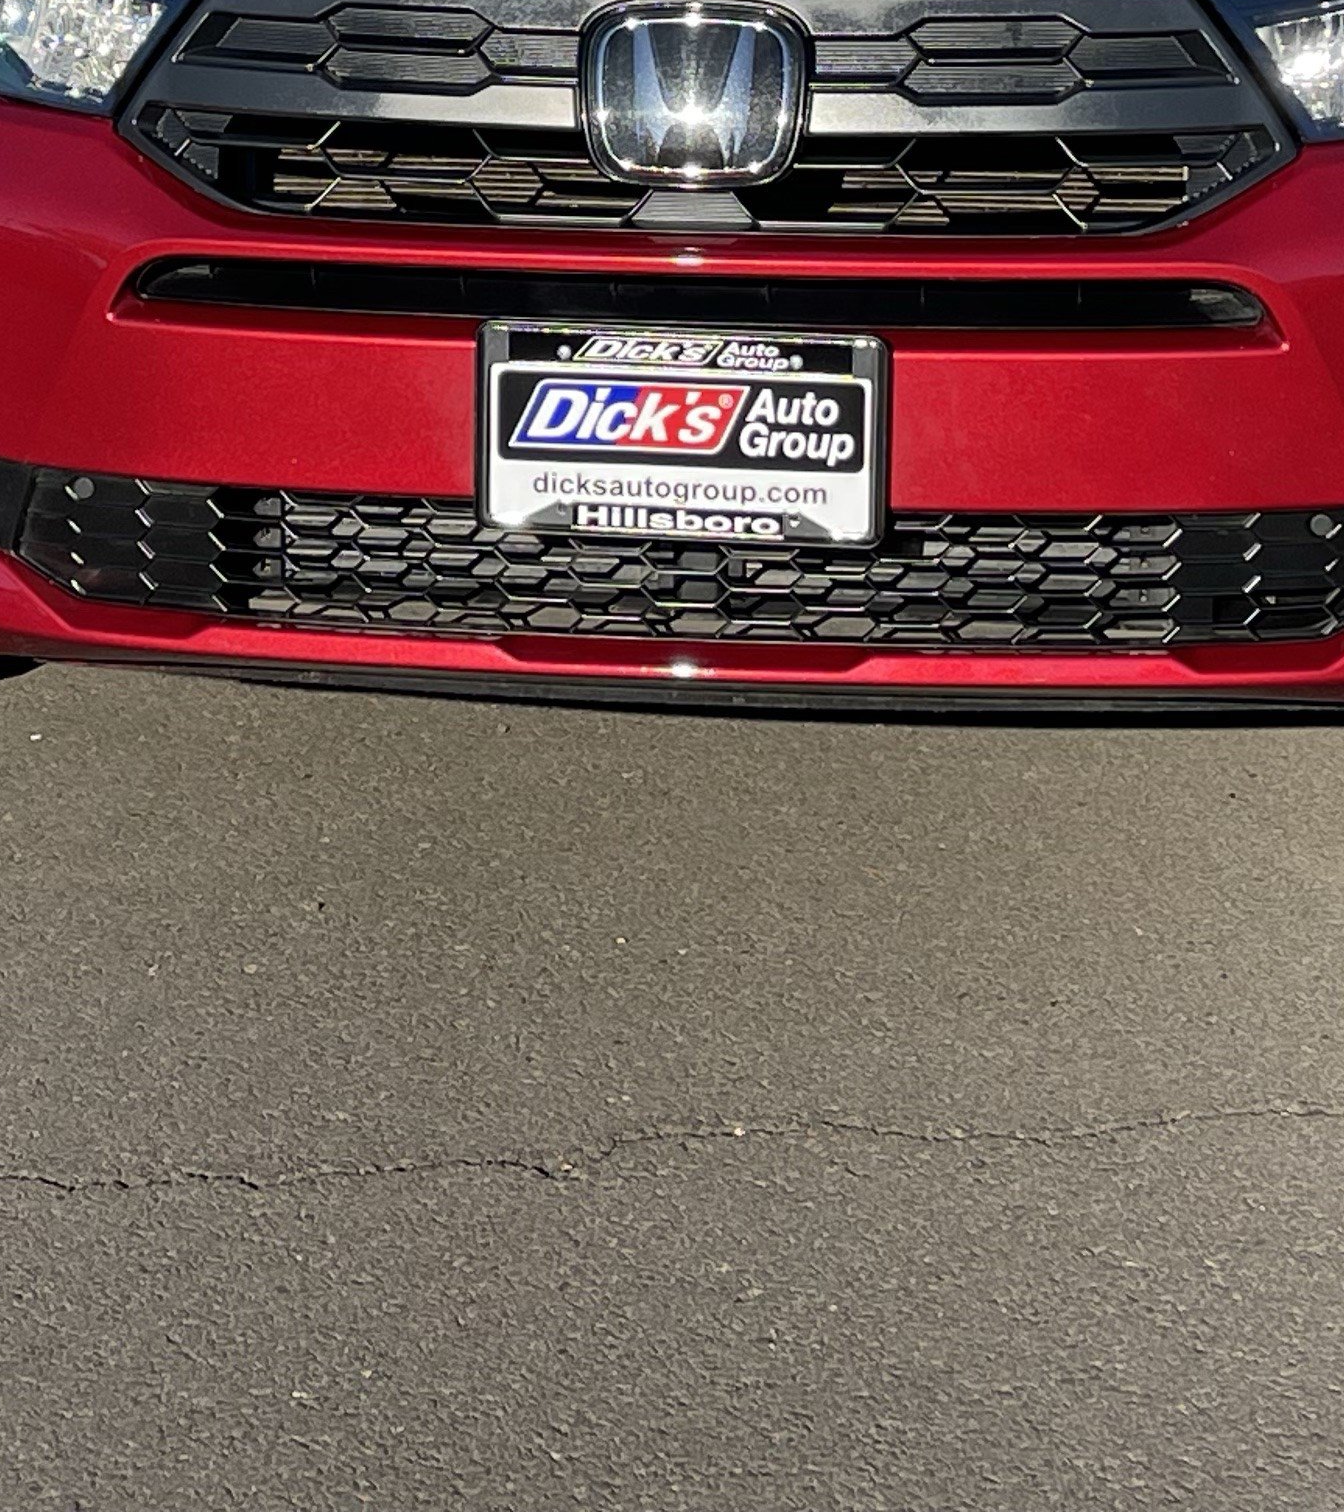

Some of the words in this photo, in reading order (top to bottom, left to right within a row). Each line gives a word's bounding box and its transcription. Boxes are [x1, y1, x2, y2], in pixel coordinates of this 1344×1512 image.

[716, 354, 790, 371] Group
[724, 341, 780, 357] Auto
[744, 388, 840, 427] Auto
[739, 422, 855, 467] Group
[532, 471, 828, 505] dicksautogroup.com
[576, 504, 781, 535] Hillsboro
